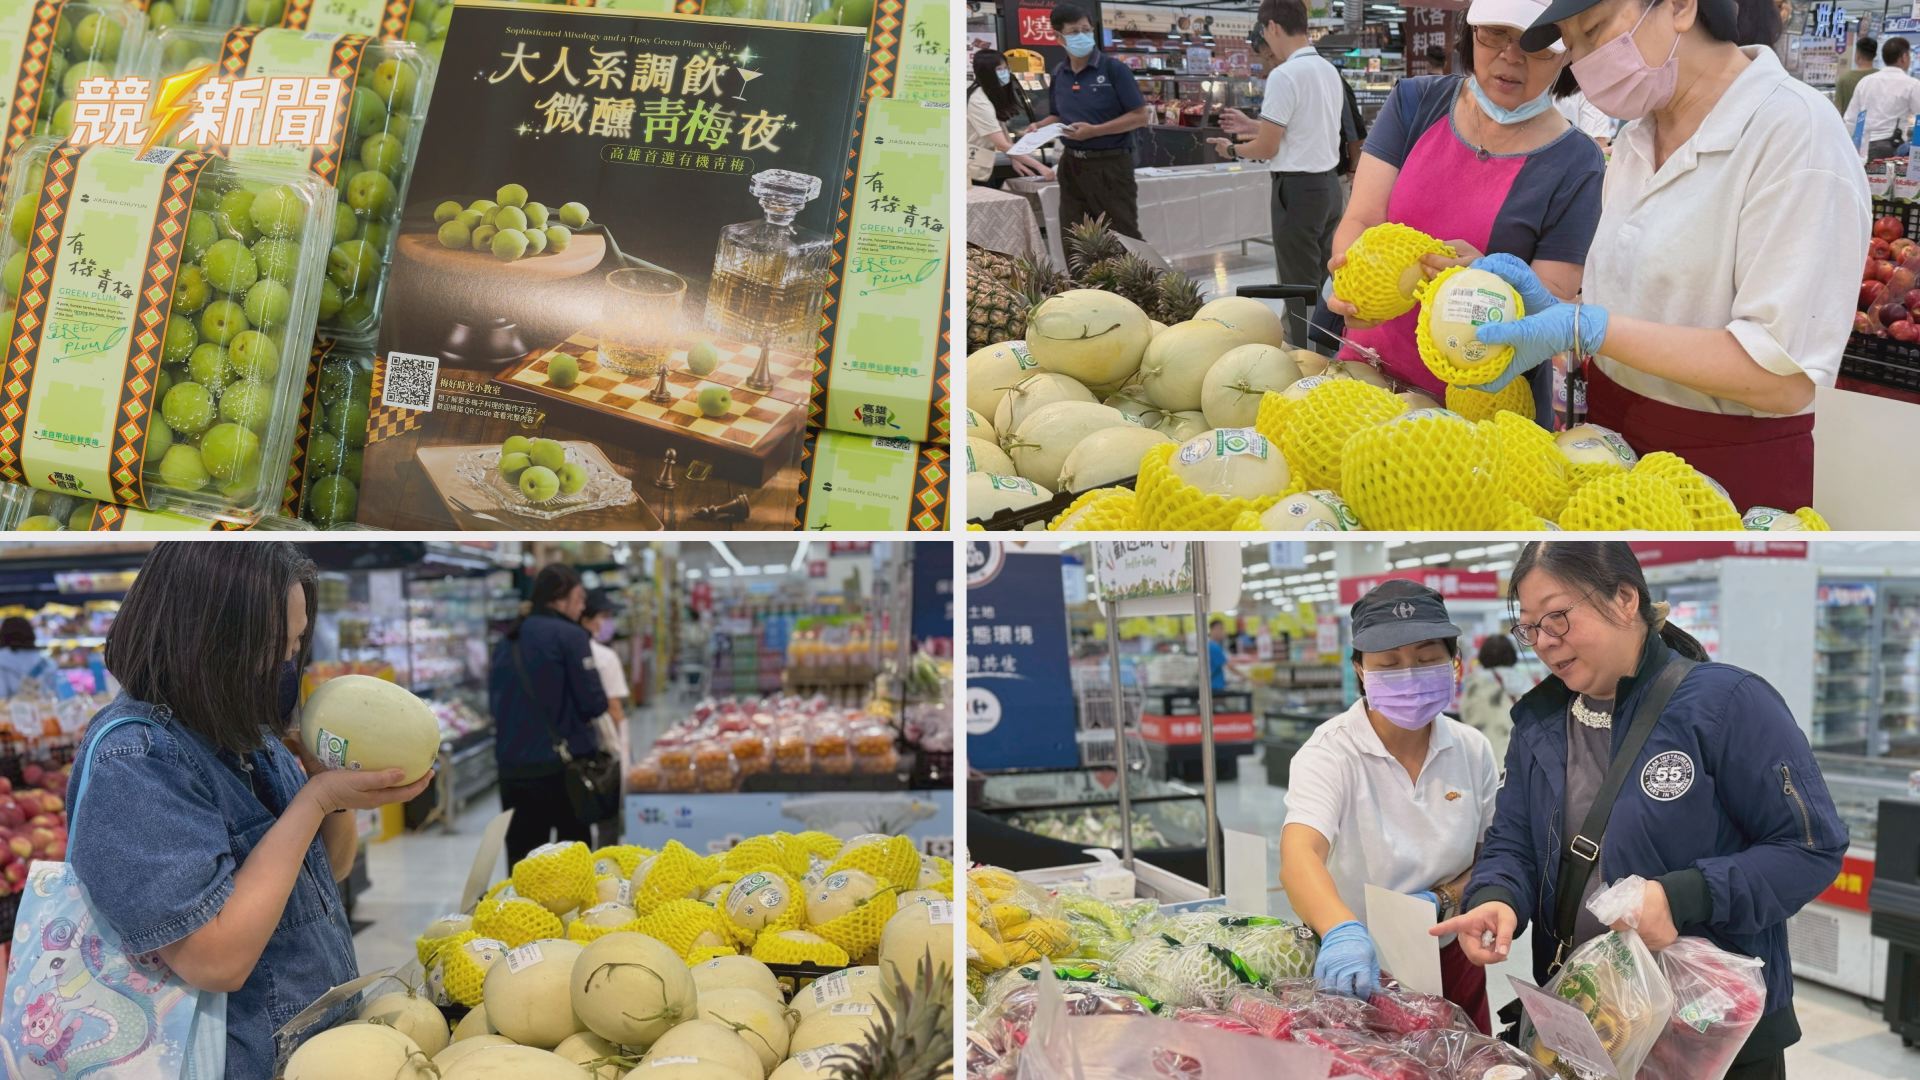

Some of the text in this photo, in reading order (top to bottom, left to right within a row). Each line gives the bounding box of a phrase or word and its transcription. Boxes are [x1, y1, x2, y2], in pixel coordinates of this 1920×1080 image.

[505, 26, 562, 38] Sophisticated
[564, 30, 601, 42] Mixology
[603, 34, 620, 42] and
[628, 35, 651, 45] Tipsy
[653, 37, 680, 46] Green
[682, 39, 705, 48] Plum
[488, 41, 730, 97] 大人系調飲
[534, 90, 787, 153] 微醺青梅夜
[610, 146, 745, 172] 高雄首選有機青梅
[860, 223, 926, 237] GREEN PLUM
[59, 287, 117, 303] GREEN PLUM
[64, 340, 100, 354] PLUM
[440, 377, 502, 396] 梅好時光小教室
[464, 406, 475, 415] QR
[475, 408, 492, 417] Code
[1655, 766, 1682, 781] 55
